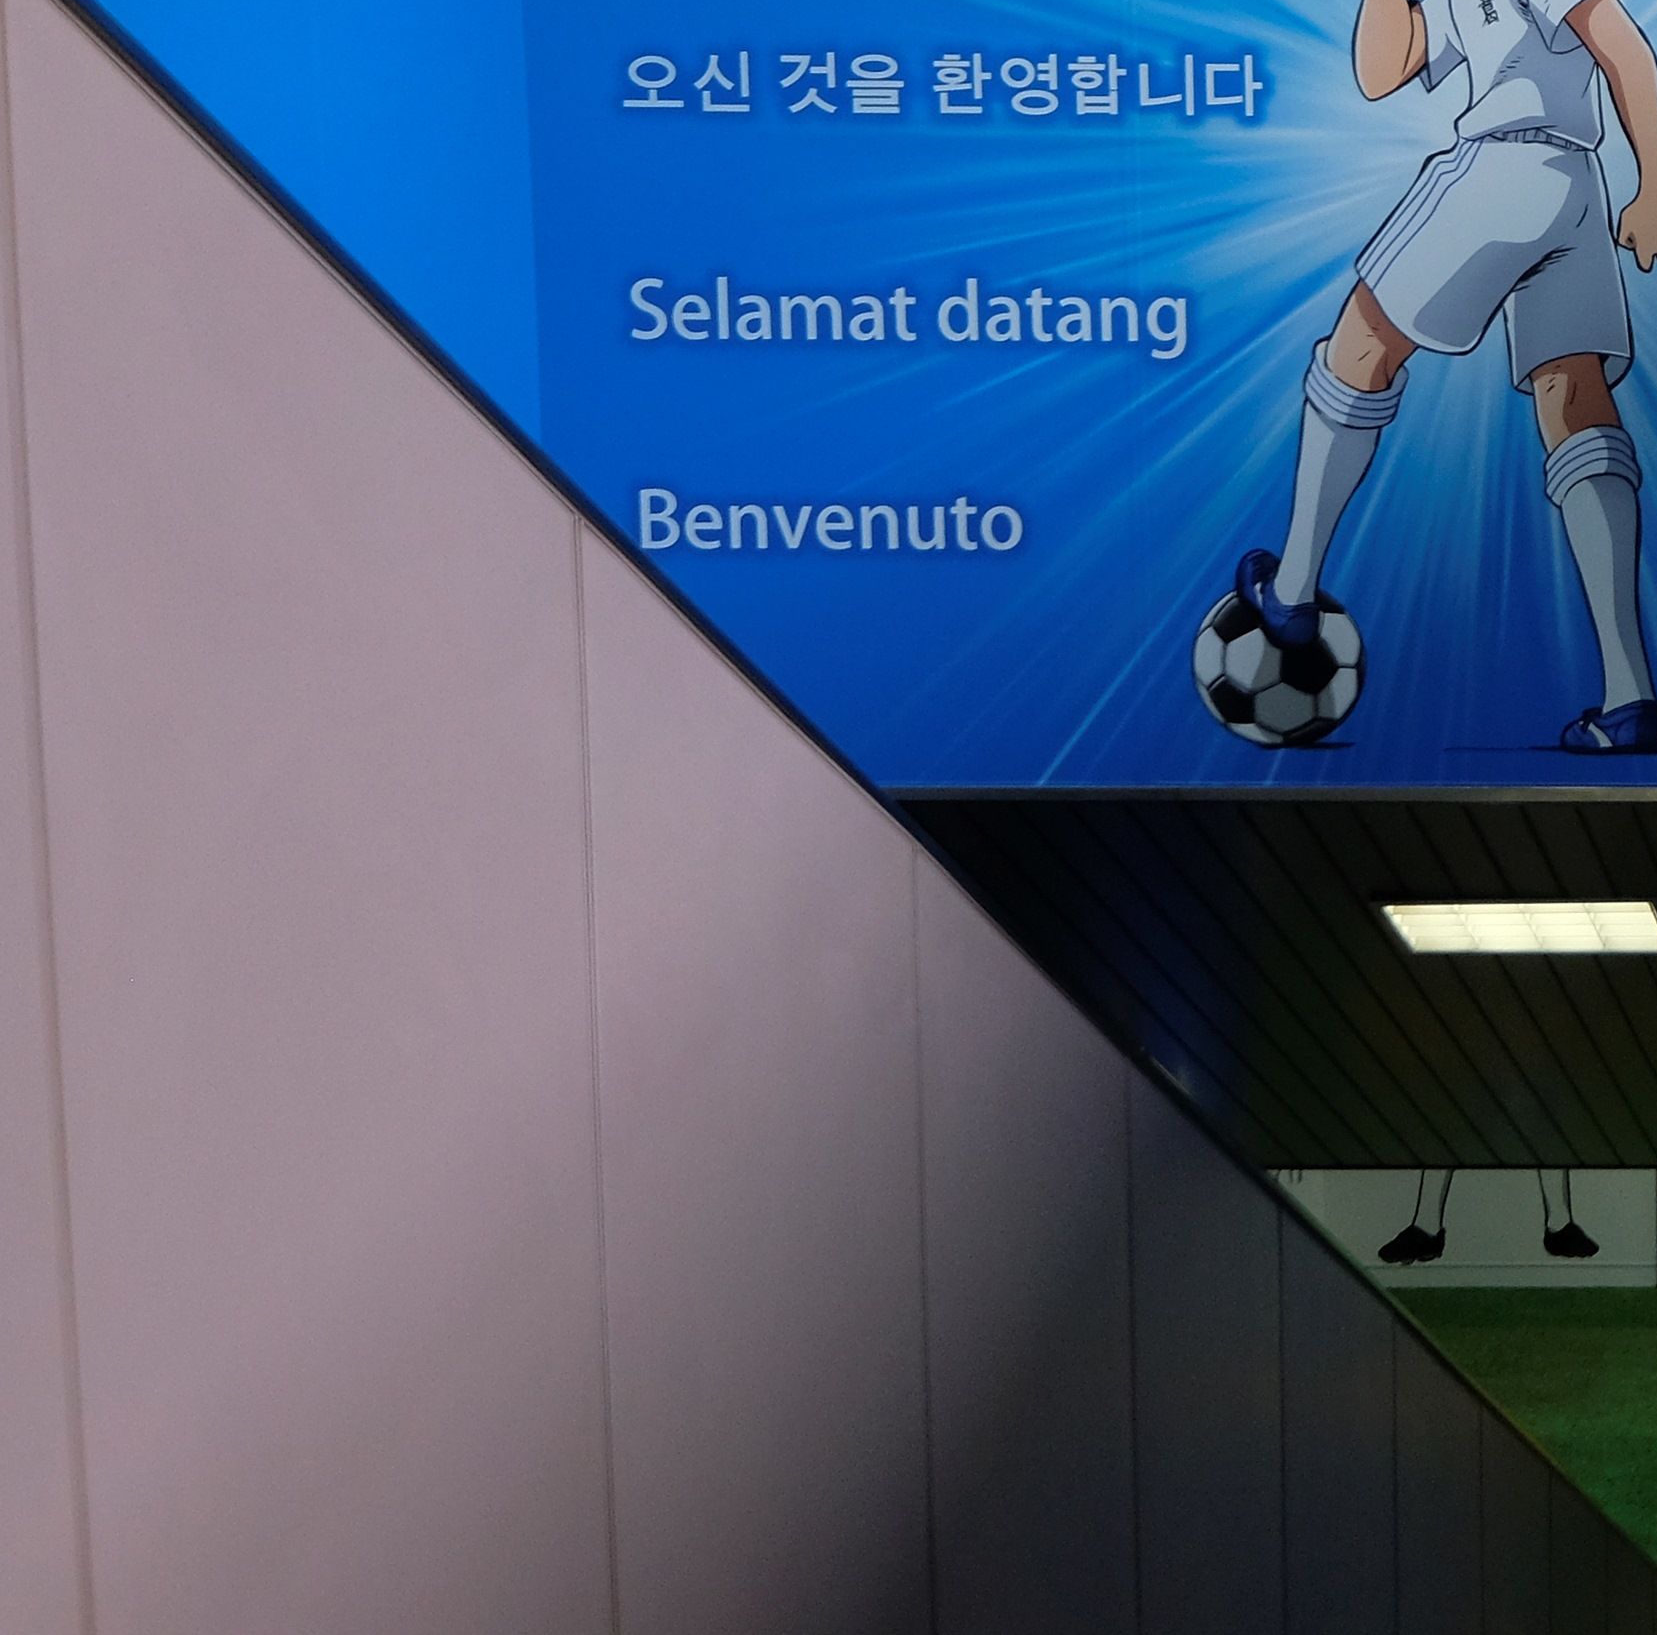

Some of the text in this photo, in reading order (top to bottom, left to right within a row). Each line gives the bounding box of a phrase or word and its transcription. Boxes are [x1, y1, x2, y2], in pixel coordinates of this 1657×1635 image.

[622, 50, 1264, 118] 오신 것을 환영합니다
[629, 276, 1188, 360] Selamat datang
[637, 487, 1024, 552] Benvenuto
